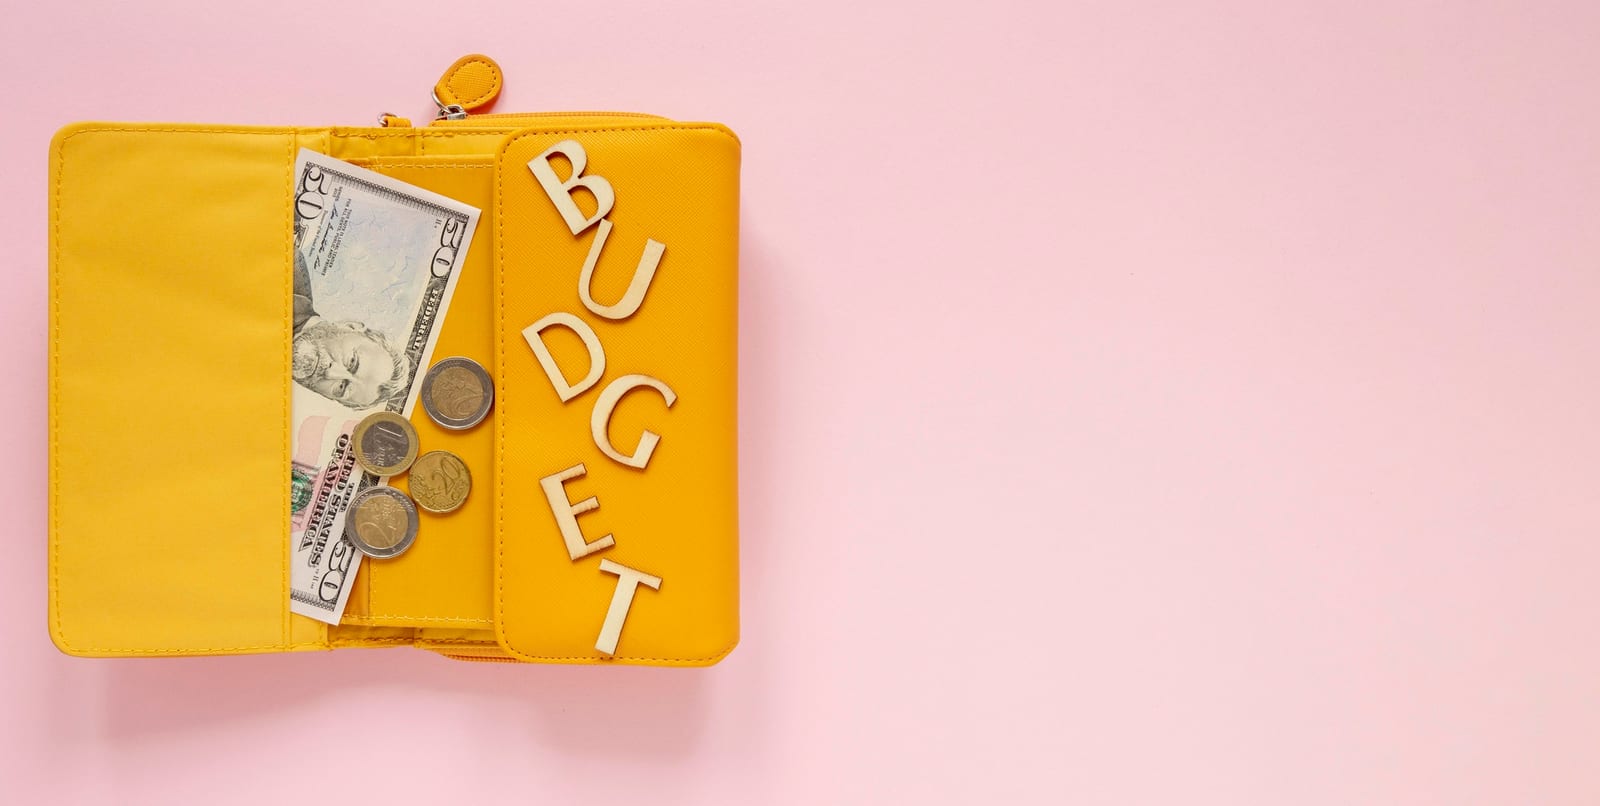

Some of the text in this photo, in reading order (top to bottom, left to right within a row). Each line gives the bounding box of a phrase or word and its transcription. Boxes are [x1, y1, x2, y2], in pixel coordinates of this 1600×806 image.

[295, 166, 332, 220] 50
[431, 217, 467, 278] 50
[412, 288, 438, 353] FEDERAL
[521, 139, 678, 656] BUDGET
[332, 433, 349, 460] OF
[299, 461, 338, 551] AMERICA
[339, 484, 355, 512] THE
[309, 495, 342, 567] STATES
[318, 541, 354, 601] 50
